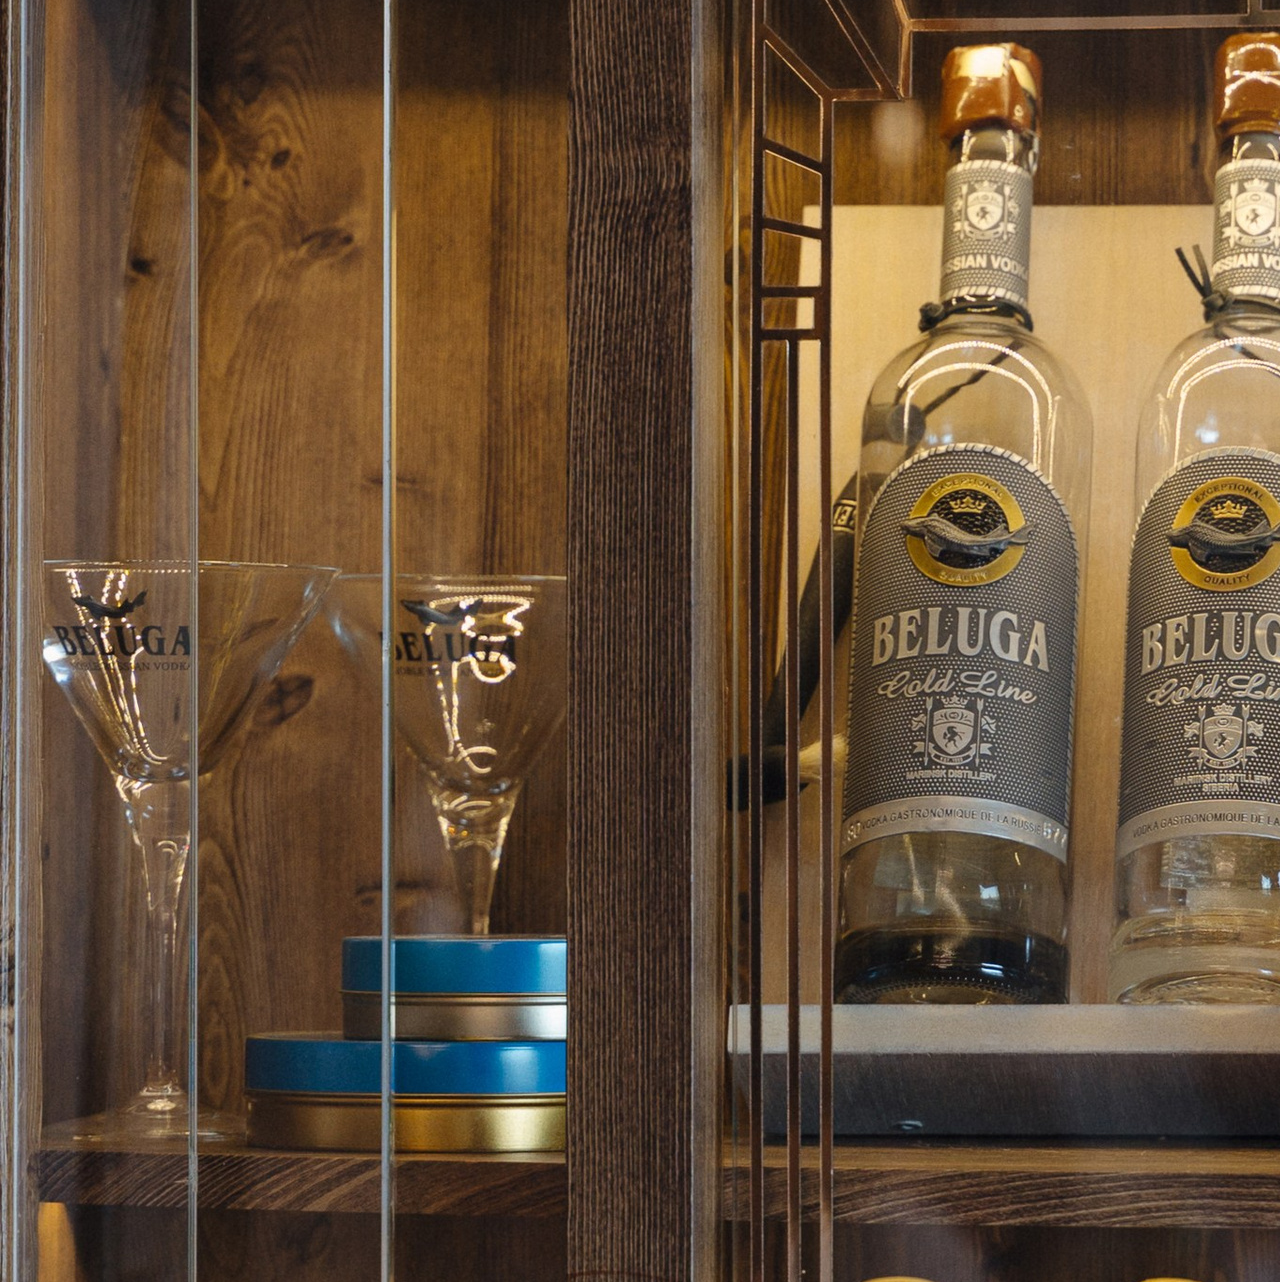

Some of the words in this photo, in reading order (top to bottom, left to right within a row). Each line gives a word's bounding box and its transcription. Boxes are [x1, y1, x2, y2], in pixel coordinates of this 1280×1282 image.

[1194, 482, 1264, 503] EXCEPTIONAL
[1203, 574, 1250, 586] QUALITY
[53, 625, 191, 656] BELUGA
[872, 607, 1050, 673] BELUGA
[877, 668, 955, 698] Gold
[960, 670, 1037, 704] Line
[1146, 673, 1222, 707] Gold
[889, 808, 977, 823] GASTRONOMIQUE
[981, 811, 994, 821] DE
[997, 815, 1010, 825] LA
[1011, 818, 1042, 835] RUSSIE
[1132, 823, 1160, 839] VODKA
[1160, 813, 1248, 829] GASTRONOMIQUE
[1251, 815, 1264, 824] DE
[1267, 817, 1280, 827] LA
